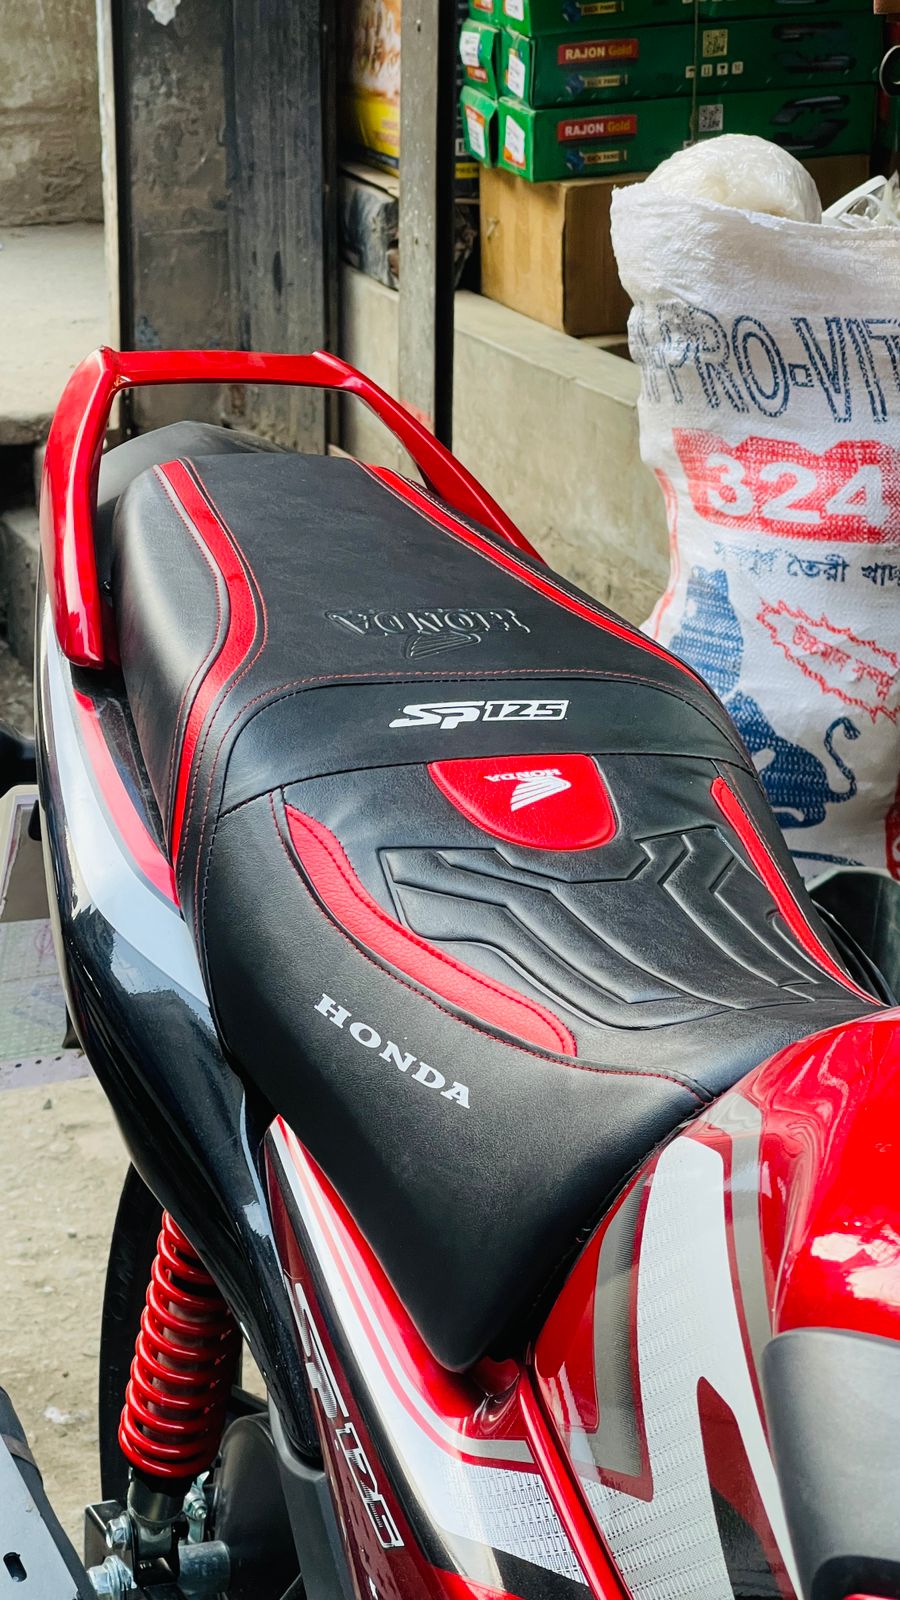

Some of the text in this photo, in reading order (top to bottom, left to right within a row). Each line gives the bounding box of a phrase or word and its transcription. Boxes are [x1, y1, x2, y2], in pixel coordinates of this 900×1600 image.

[565, 46, 606, 60] RAJON
[565, 121, 631, 137] RAJON Gold
[705, 452, 890, 526] 324
[325, 607, 531, 636] HONDA
[483, 768, 562, 782] HONDA
[314, 993, 470, 1109] HONDA
